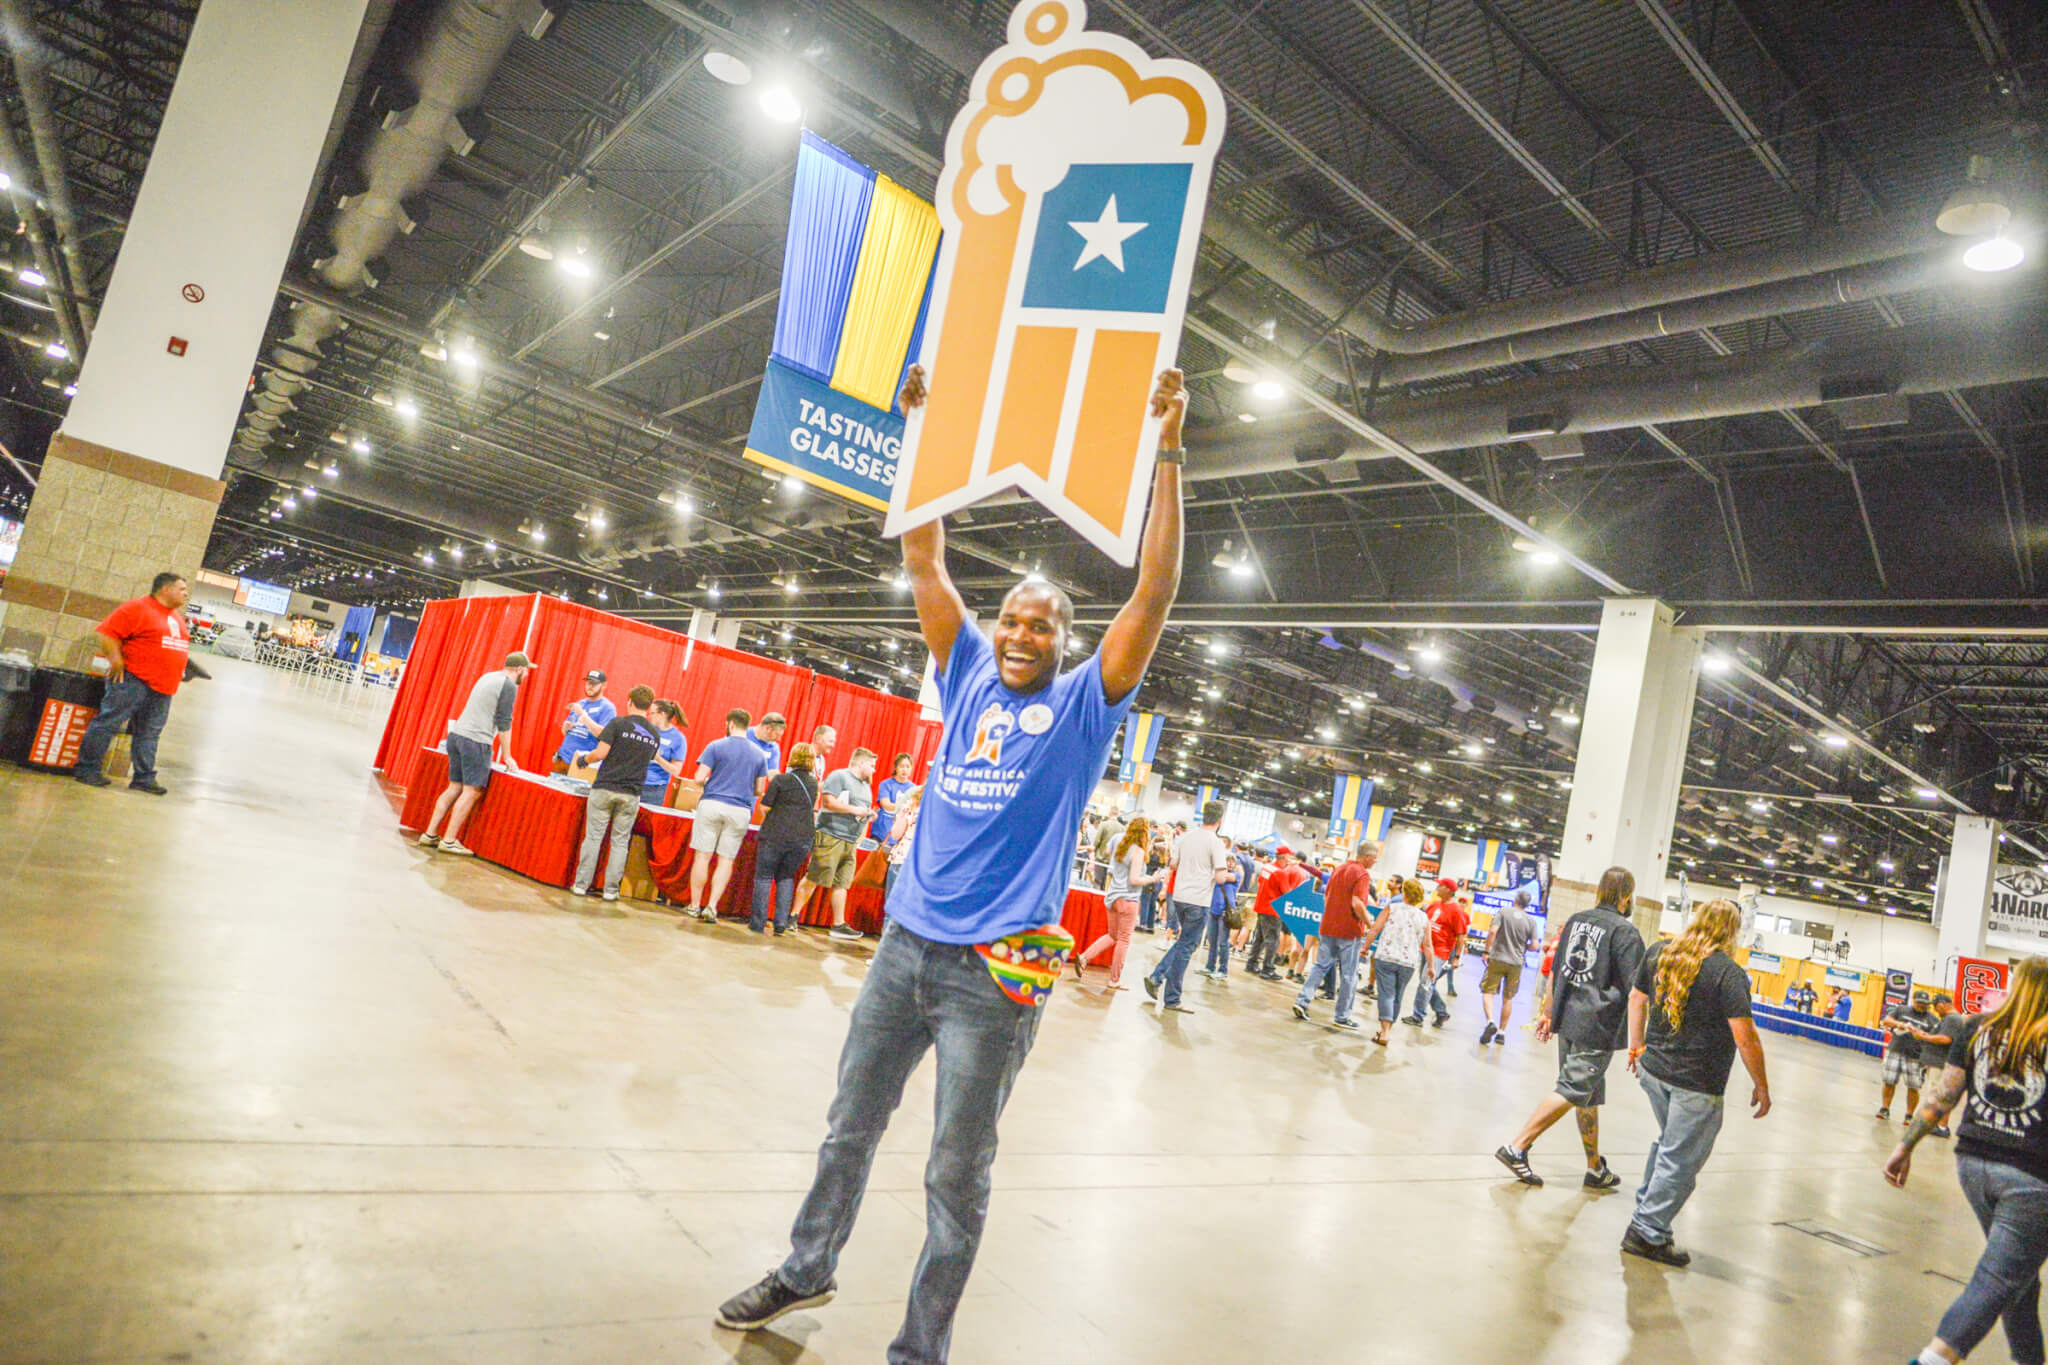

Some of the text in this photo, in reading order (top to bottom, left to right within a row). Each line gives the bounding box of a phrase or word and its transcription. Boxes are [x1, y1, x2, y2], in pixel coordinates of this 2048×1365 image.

[800, 398, 900, 459] TASTING
[790, 427, 896, 487] GLASSES
[966, 769, 1030, 780] AMERICA
[1284, 901, 1321, 922] Entra
